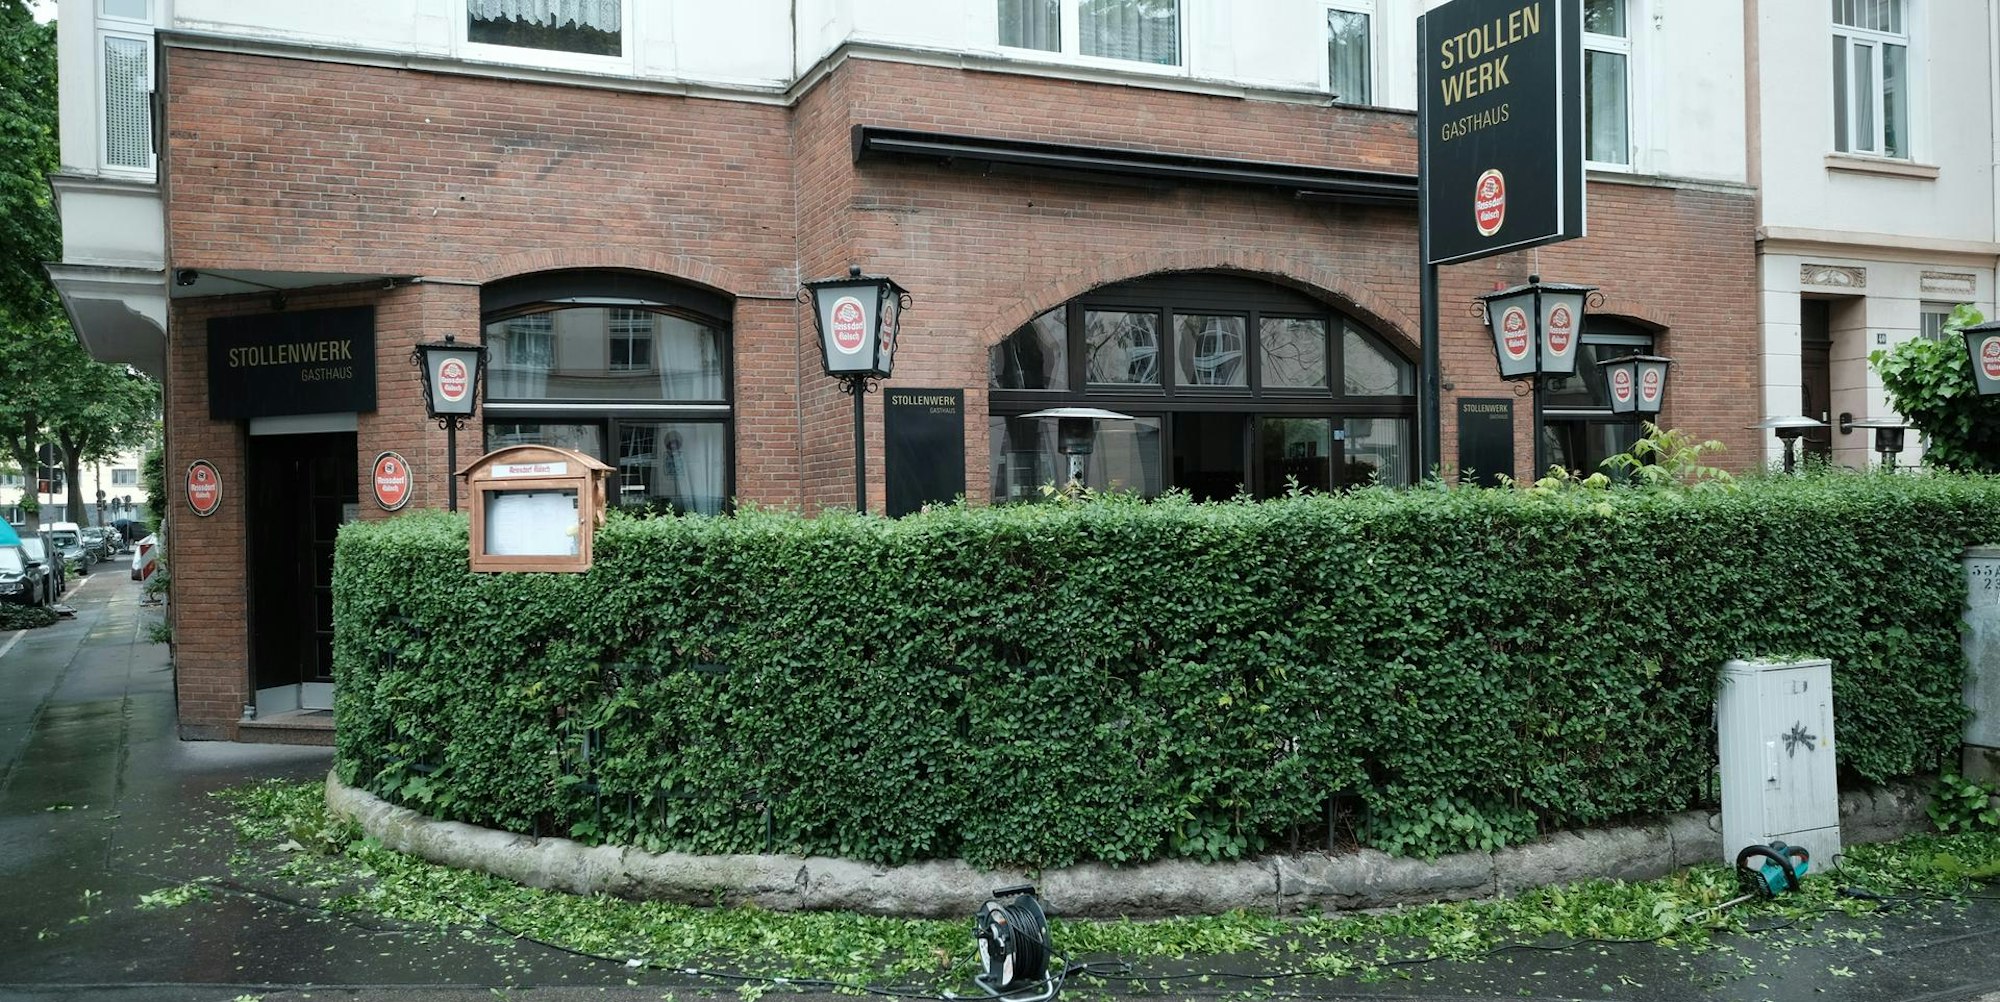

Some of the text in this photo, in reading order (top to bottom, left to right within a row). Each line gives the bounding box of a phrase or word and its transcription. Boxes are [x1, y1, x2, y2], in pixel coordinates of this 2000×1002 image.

[1441, 2, 1540, 70] STOLLEN
[1441, 54, 1510, 107] WERK
[1441, 103, 1510, 141] GASTHAUS
[229, 340, 352, 368] STOLLENWERK
[301, 366, 352, 381] GASTHAUS
[892, 395, 955, 406] STOLLENWERK
[1463, 404, 1508, 413] STOLLENWERK
